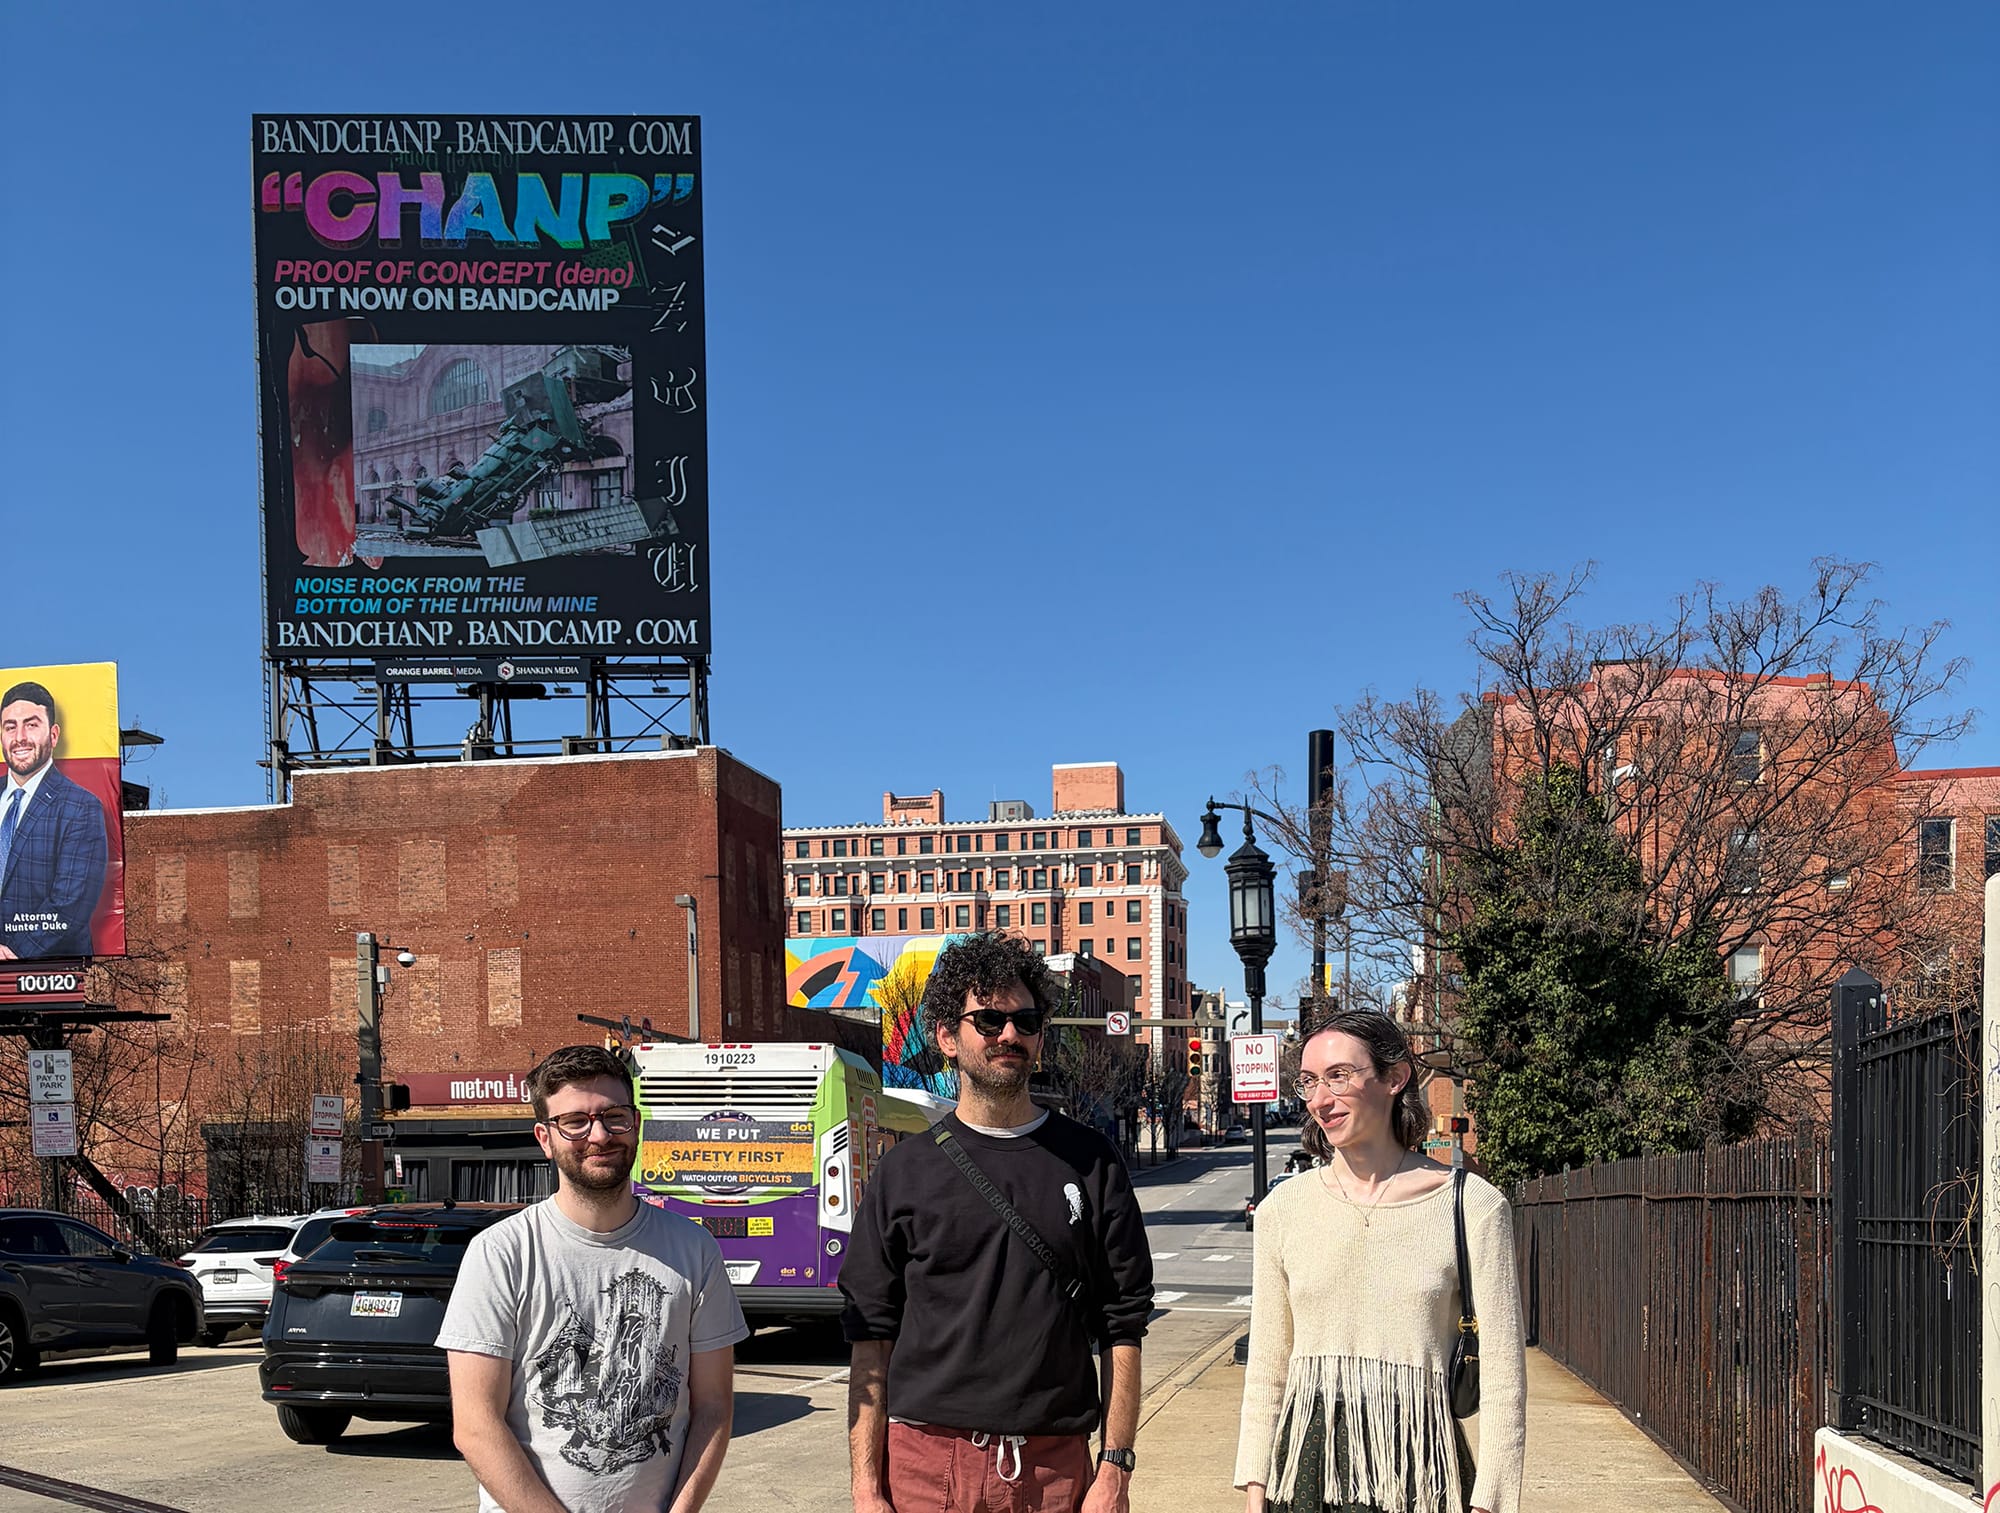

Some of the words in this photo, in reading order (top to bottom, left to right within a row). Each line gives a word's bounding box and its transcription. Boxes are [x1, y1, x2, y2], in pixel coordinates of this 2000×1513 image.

[274, 261, 372, 284] PROOF
[375, 261, 415, 284] OF
[418, 261, 552, 284] CONCEPT
[555, 261, 634, 288] (deno)
[275, 287, 336, 311] OUT
[340, 287, 409, 311] NOW
[412, 287, 455, 311] ON
[459, 287, 620, 312] BANDCAMP
[294, 577, 358, 594] NOISE
[361, 577, 420, 593] ROCK
[423, 577, 482, 593] FROM
[486, 576, 526, 593] THE
[295, 598, 382, 614] BOTTOM
[386, 598, 414, 614] OF
[418, 598, 458, 614] THE
[461, 598, 543, 614] LITHIUM
[546, 597, 598, 613] MINE
[386, 668, 421, 676] ORANGE
[422, 668, 453, 676] BARREL
[456, 667, 483, 676] MEDIA
[516, 666, 553, 675] SHANKLIN
[554, 666, 579, 675] MEDIA
[13, 913, 58, 922] Attorney
[5, 923, 39, 932] Hunter
[42, 922, 68, 931] Duke
[18, 974, 76, 991] 100120
[1245, 1043, 1263, 1055] NO
[704, 1054, 756, 1065] 1910223
[1236, 1062, 1274, 1075] STOPPING
[450, 1078, 503, 1099] metro
[322, 1100, 335, 1108] NO
[314, 1111, 341, 1119] STOPPING
[790, 1122, 813, 1132] dot
[696, 1128, 721, 1140] WE
[727, 1128, 761, 1140] PUT
[671, 1150, 735, 1162] SAFETY
[738, 1151, 785, 1163] FIRST
[682, 1174, 706, 1183] WATCH
[707, 1174, 722, 1183] OUT
[722, 1174, 738, 1183] FOR
[738, 1174, 792, 1184] BICYCLISTS
[340, 1278, 410, 1286] NISSAN
